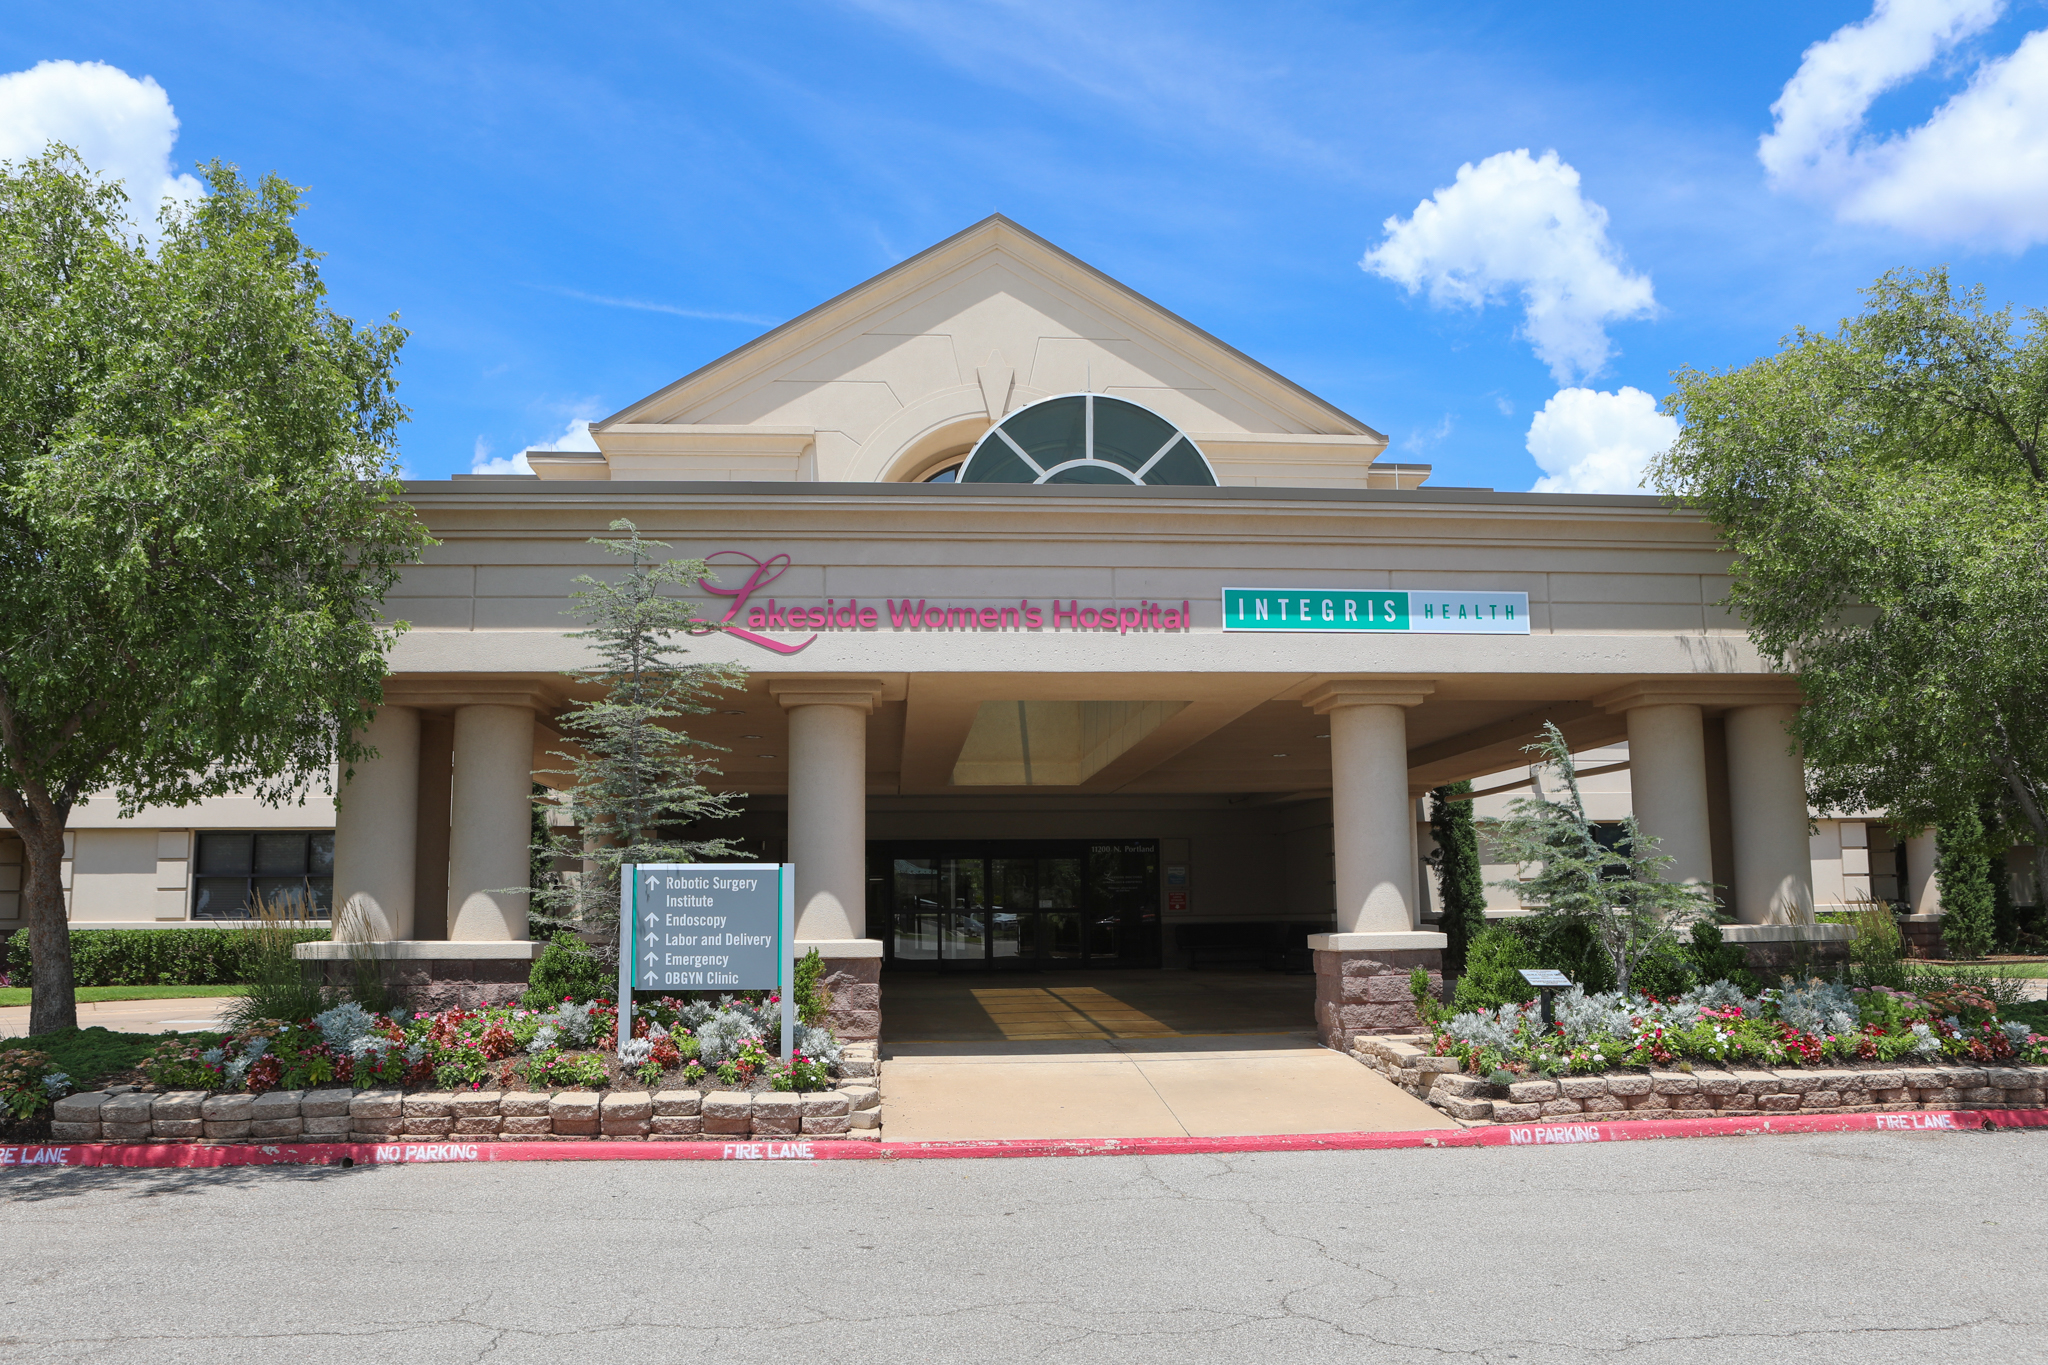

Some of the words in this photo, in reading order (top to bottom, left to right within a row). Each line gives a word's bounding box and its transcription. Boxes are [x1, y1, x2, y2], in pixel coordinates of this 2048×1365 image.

[686, 551, 878, 653] Lakeside
[887, 599, 1043, 628] Women's
[1053, 599, 1190, 635] Hospital
[1238, 598, 1396, 622] INTEGRIS
[1424, 603, 1514, 620] HEALTH
[1124, 845, 1154, 853] Portland
[666, 876, 709, 889] Robotic
[712, 876, 757, 892] Surgery
[666, 895, 714, 907] Institute
[665, 914, 726, 928] Endoscopy
[665, 933, 698, 946] Labor
[701, 933, 722, 946] and
[725, 933, 772, 948] Delivery
[665, 953, 729, 968] Emergency
[665, 972, 703, 985] OBGYN
[707, 971, 739, 985] Clinic
[1875, 1115, 1911, 1129] FIRE
[1913, 1114, 1955, 1129] LANE
[1509, 1128, 1532, 1144] NO
[1534, 1126, 1600, 1143] PARKING
[20, 1147, 71, 1164] LANE
[376, 1146, 401, 1161] NO
[405, 1144, 478, 1160] PARKING
[723, 1144, 763, 1159] FIRE
[768, 1143, 815, 1158] LANE
